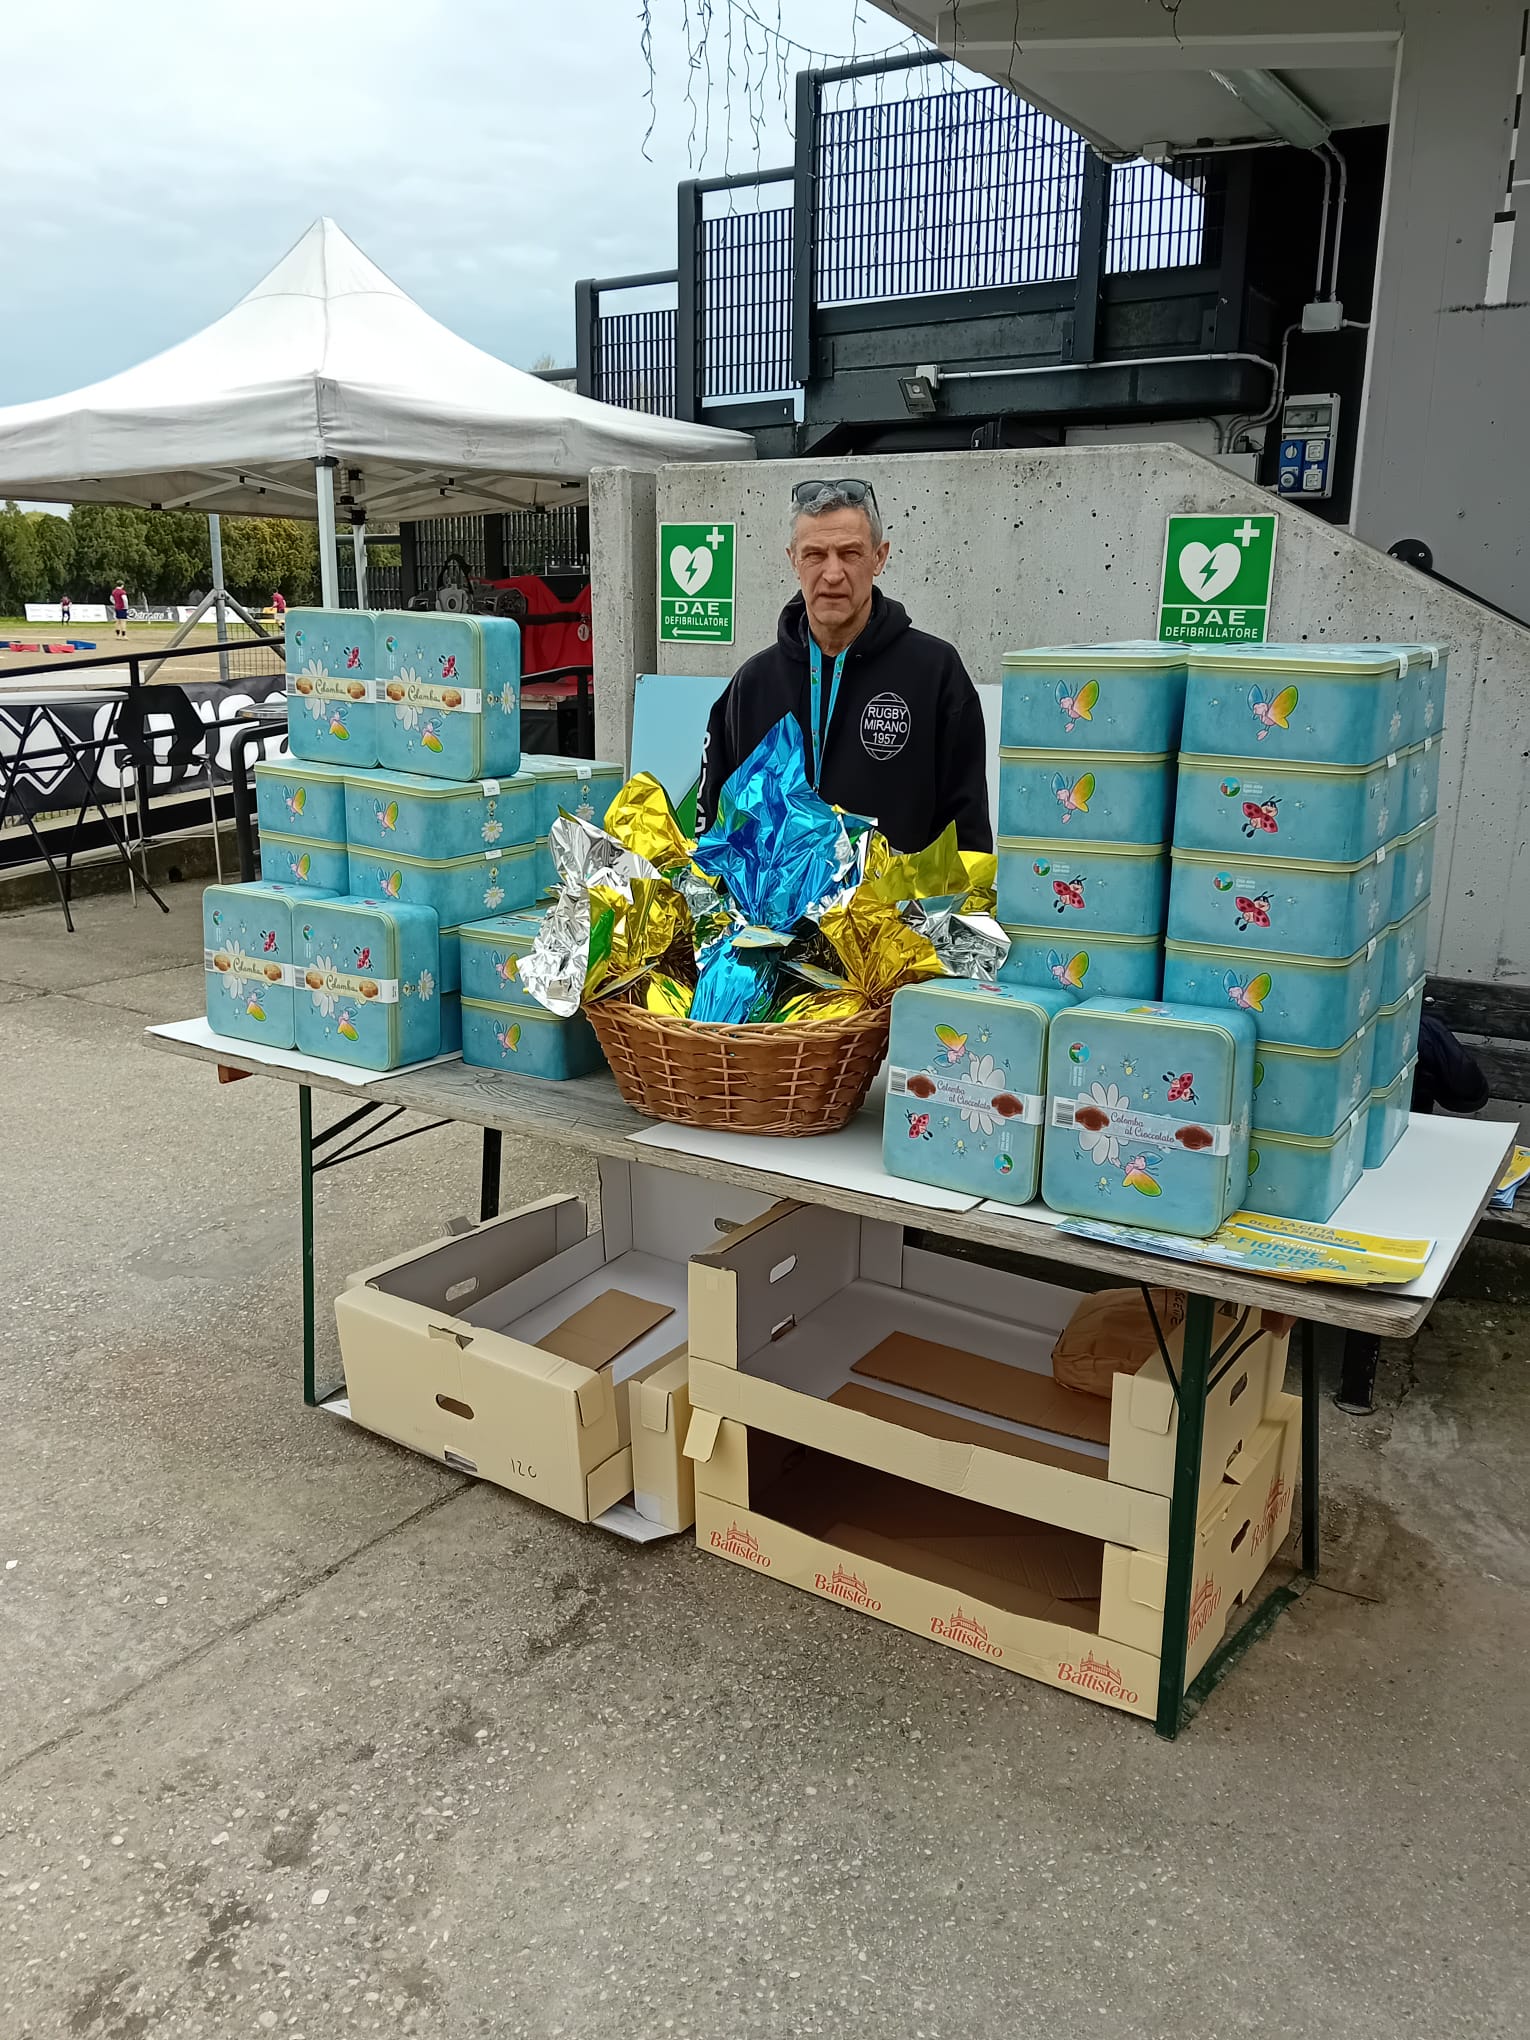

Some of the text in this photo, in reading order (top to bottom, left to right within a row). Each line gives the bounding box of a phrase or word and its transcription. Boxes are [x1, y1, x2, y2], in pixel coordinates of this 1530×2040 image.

[674, 601, 720, 616] DAE
[664, 616, 729, 627] DEFIBRILLATORE
[1180, 609, 1247, 626] DAE
[1165, 626, 1258, 639] DEFIBRILLATORE
[867, 706, 907, 720] RUGBY
[864, 718, 908, 733] MIRANO
[872, 732, 897, 745] 1957
[936, 1080, 965, 1095] Colomba
[1110, 1111, 1144, 1128] Colomba
[1124, 1126, 1175, 1144] al Cioccolato
[1237, 1236, 1321, 1260] FIORIRE
[1249, 1249, 1348, 1272] RICERCA
[709, 1530, 772, 1568] Battistero
[814, 1573, 882, 1612] Battistero
[930, 1616, 1003, 1658] Battistero
[1057, 1662, 1139, 1704] Battistero
